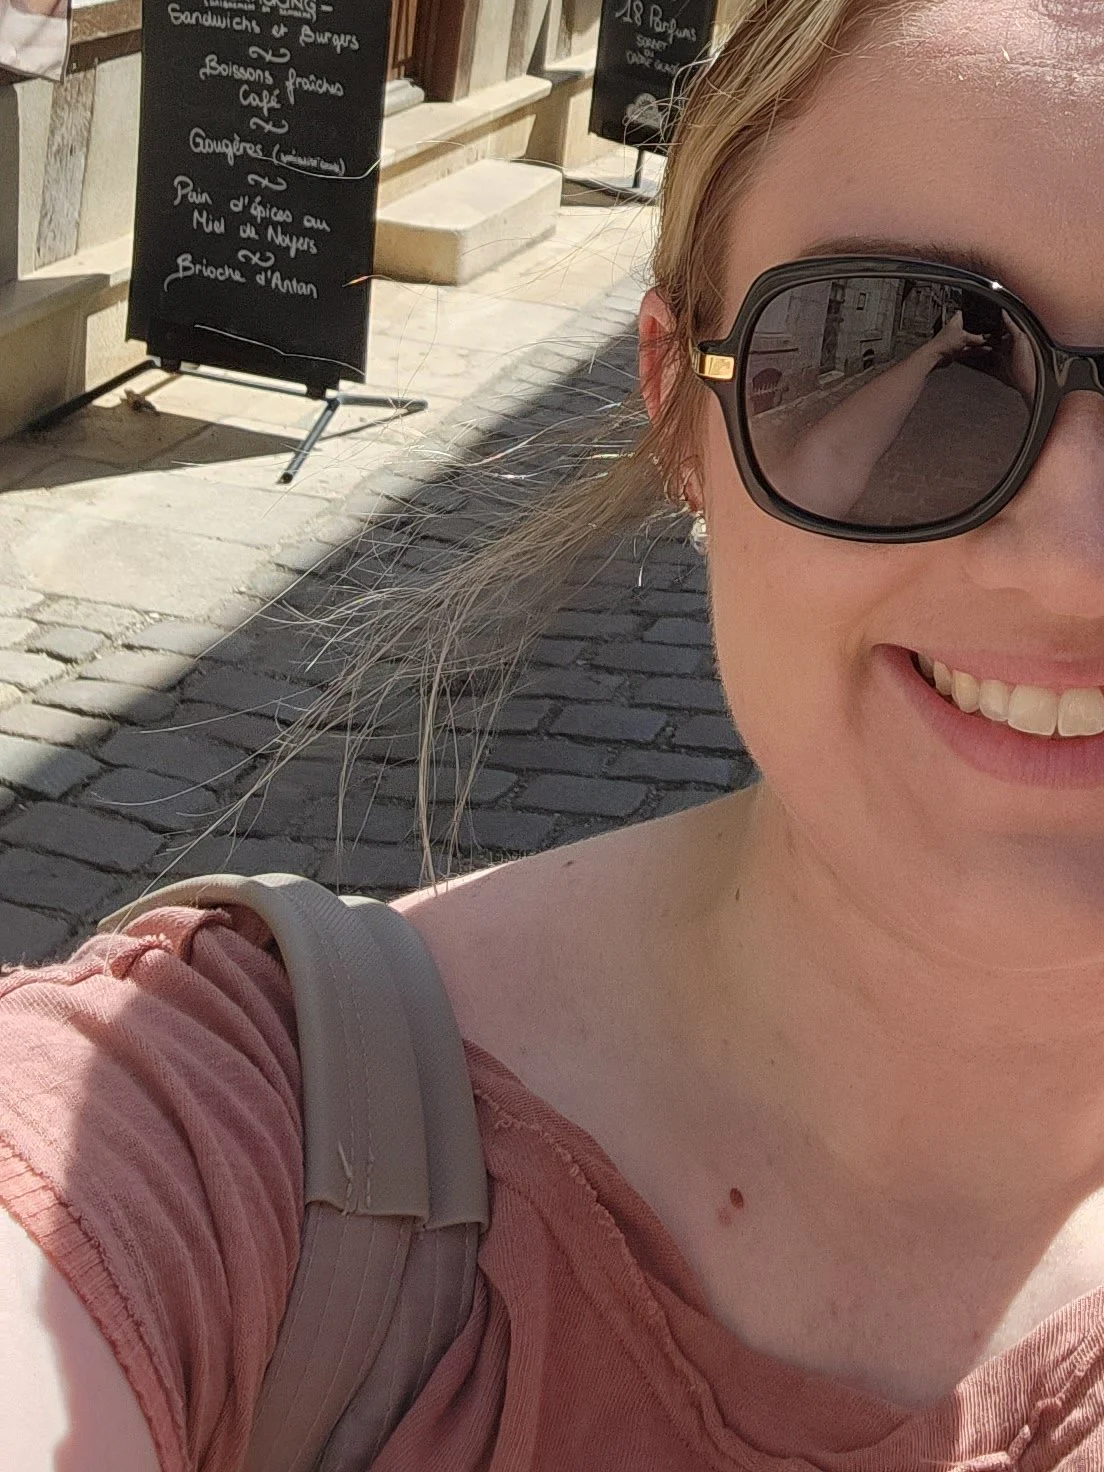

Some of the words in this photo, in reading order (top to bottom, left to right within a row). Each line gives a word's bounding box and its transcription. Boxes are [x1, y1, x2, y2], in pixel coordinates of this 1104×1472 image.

[168, 3, 261, 34] Sandwichs
[300, 25, 360, 55] Burgers
[200, 55, 274, 86] Boissons
[286, 68, 344, 105] fraîches
[239, 85, 281, 117] Café
[189, 127, 263, 166] Gougères
[173, 175, 212, 206] Pain
[230, 195, 293, 224] d'épices
[303, 216, 331, 232] au
[193, 209, 225, 234] Miel
[240, 223, 259, 240] de
[267, 225, 317, 258] Noyers
[164, 253, 246, 293] Brioche
[256, 269, 318, 299] d'Antan
